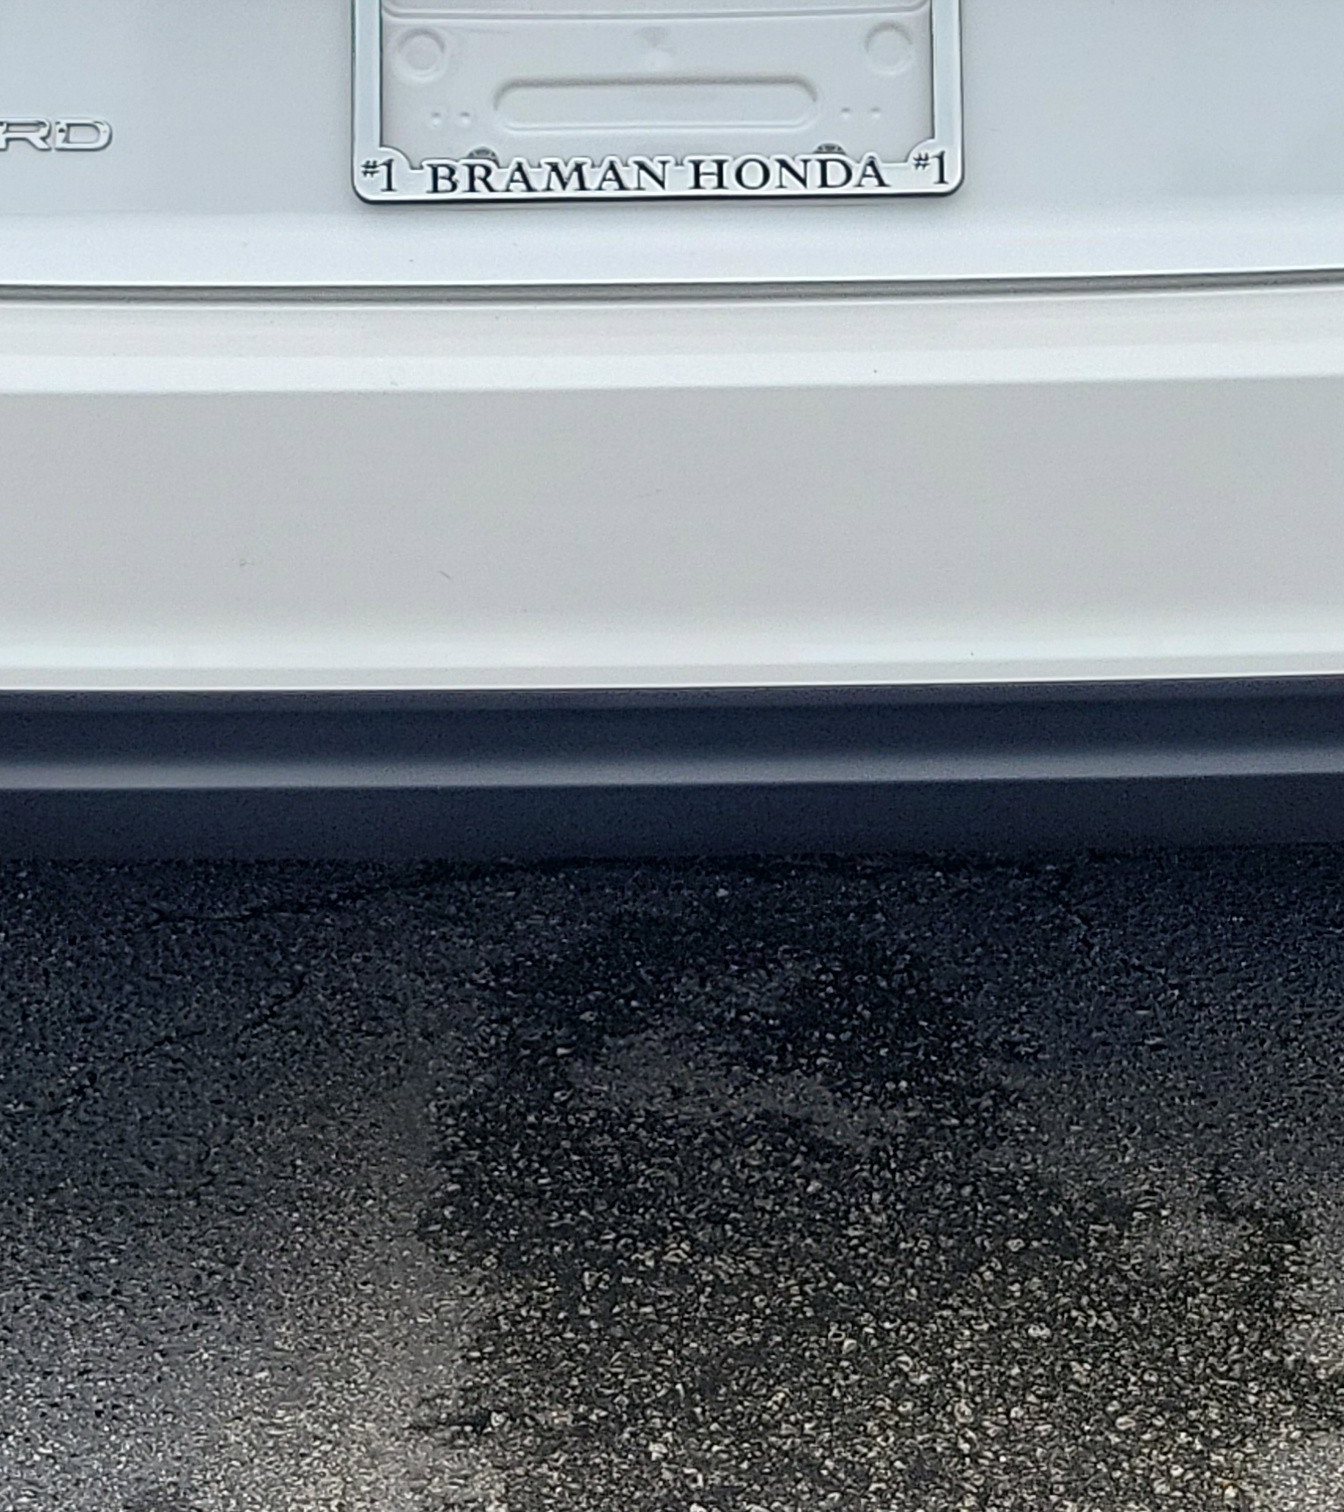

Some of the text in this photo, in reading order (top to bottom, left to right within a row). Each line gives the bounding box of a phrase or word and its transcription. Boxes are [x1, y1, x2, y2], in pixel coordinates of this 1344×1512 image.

[360, 150, 949, 194] #1 BRAMAN HONDA #1
